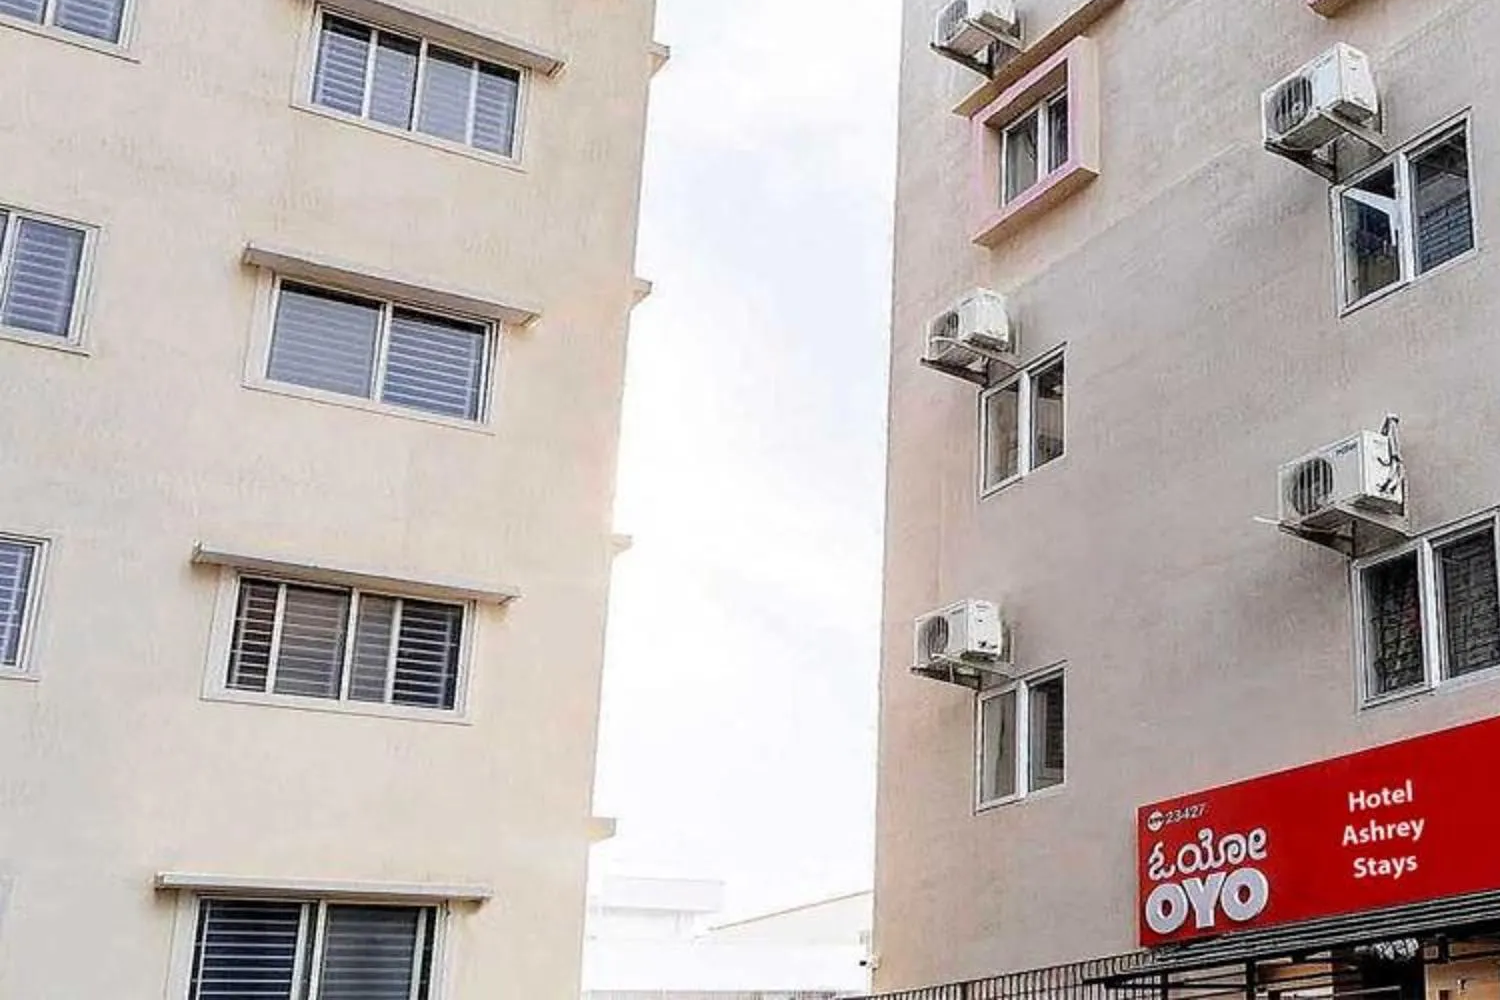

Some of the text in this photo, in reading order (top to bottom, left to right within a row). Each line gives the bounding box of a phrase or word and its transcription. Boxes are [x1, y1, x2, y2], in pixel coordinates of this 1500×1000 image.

[1348, 779, 1413, 812] Hotel
[1342, 818, 1425, 846] Ashrey
[1353, 855, 1418, 880] Stays
[1145, 867, 1269, 934] OYO
